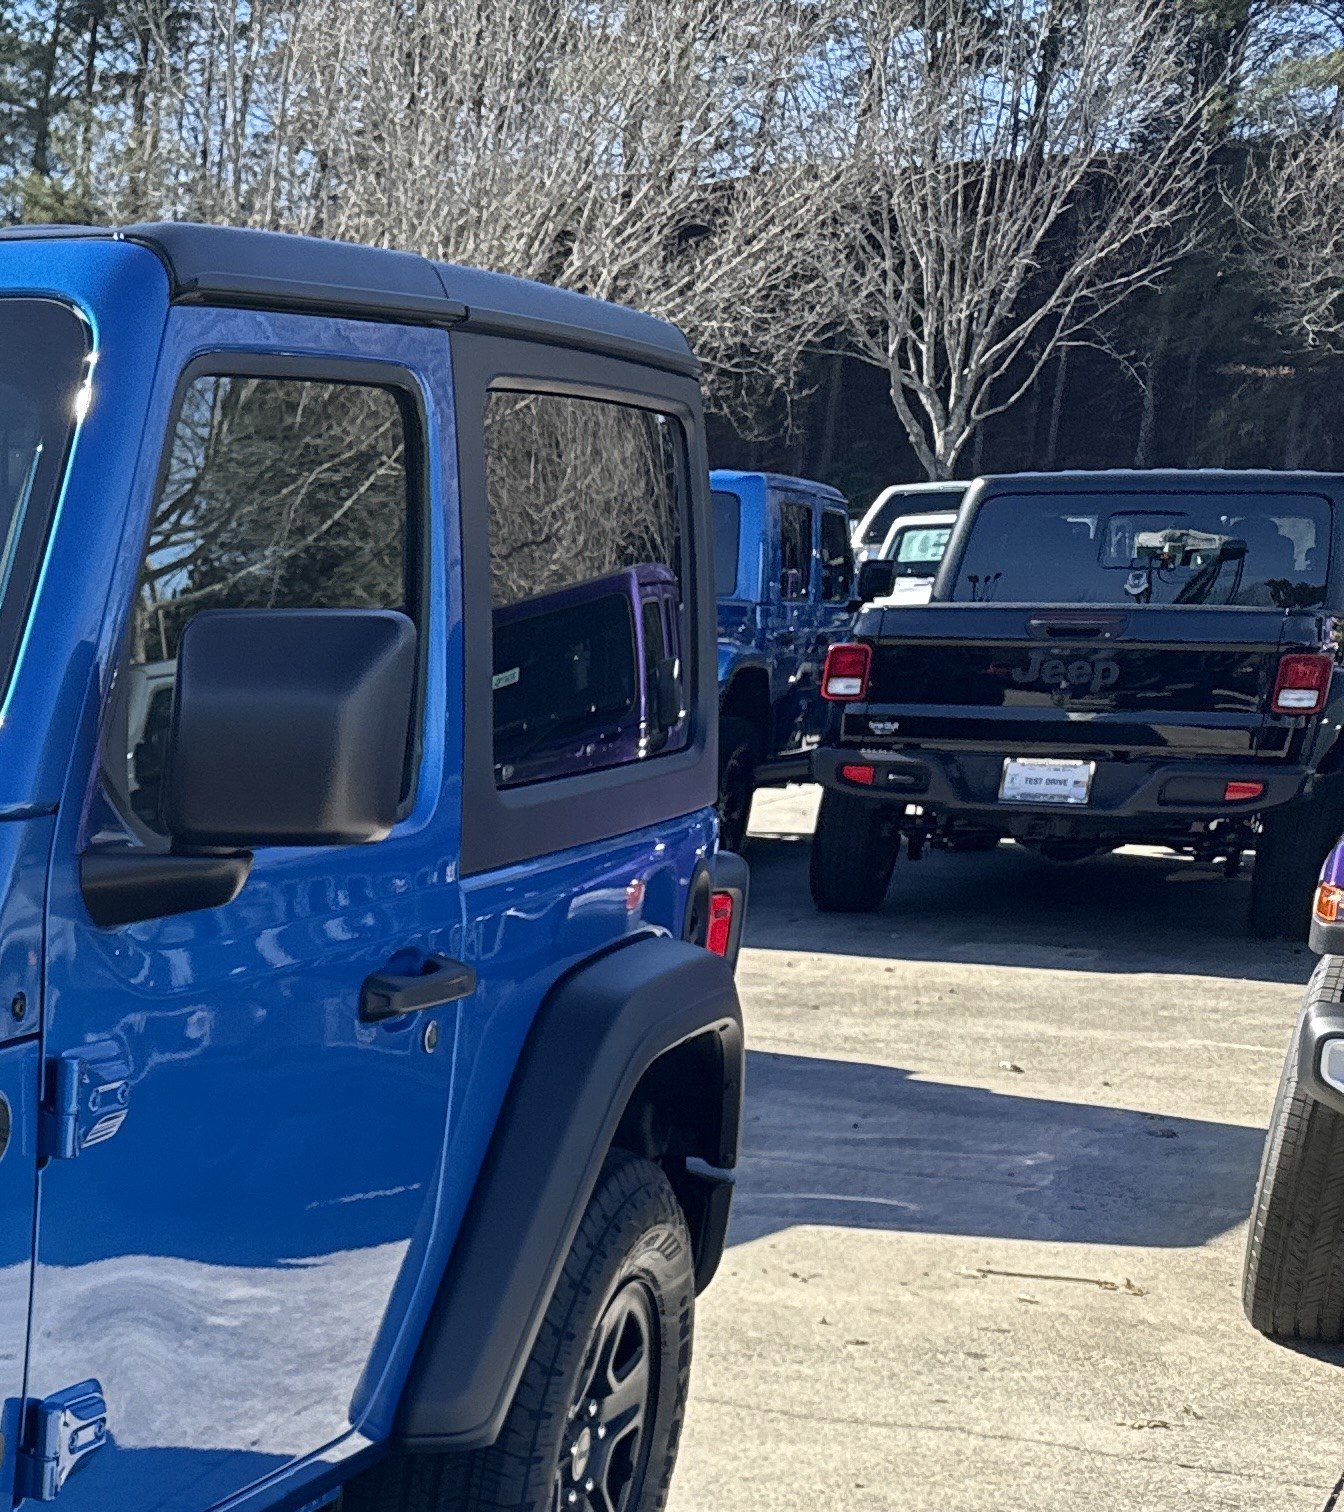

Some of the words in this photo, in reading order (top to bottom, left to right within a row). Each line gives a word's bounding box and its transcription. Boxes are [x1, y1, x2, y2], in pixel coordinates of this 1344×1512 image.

[1012, 648, 1120, 693] Jeep
[1024, 777, 1044, 786] TEST
[1045, 777, 1069, 787] DRIVE
